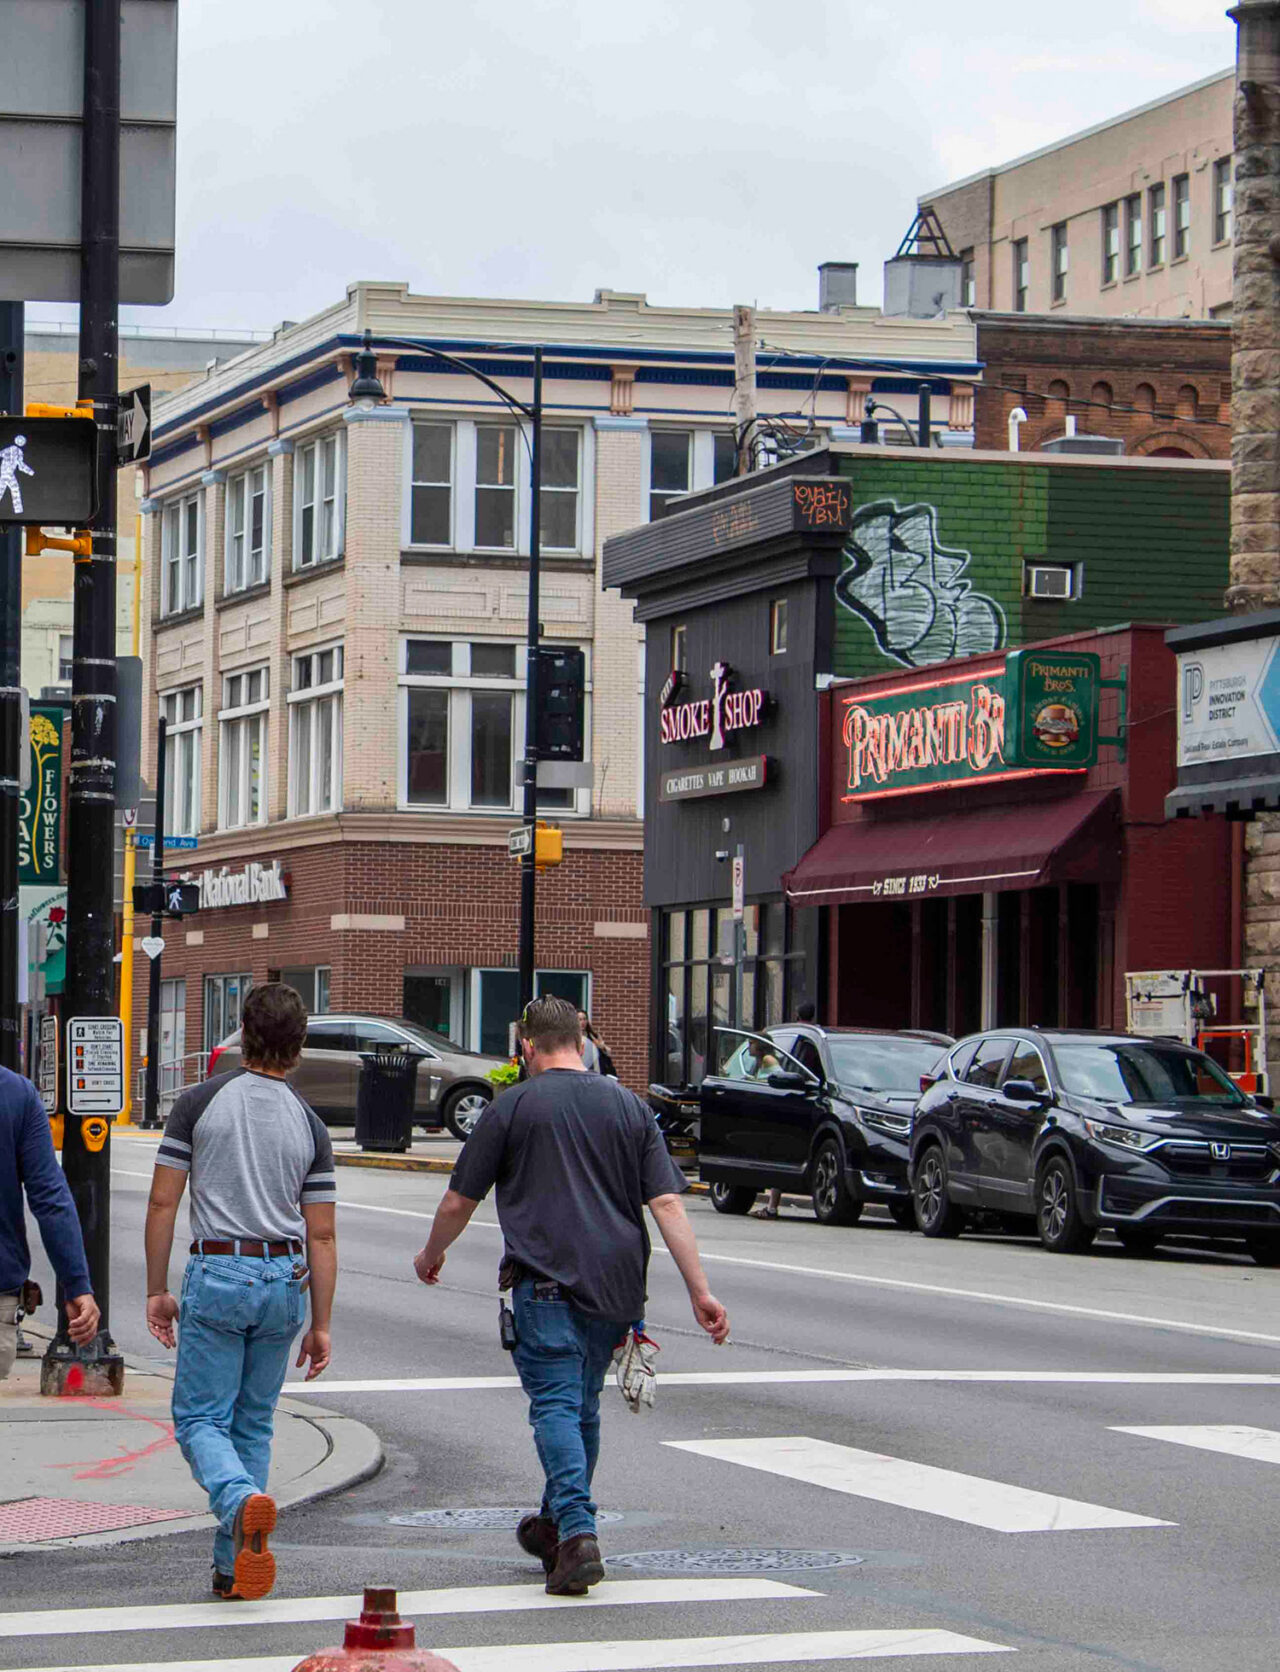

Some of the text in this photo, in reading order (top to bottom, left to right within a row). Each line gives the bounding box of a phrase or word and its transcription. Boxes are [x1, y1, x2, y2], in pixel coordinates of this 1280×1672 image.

[1031, 661, 1090, 680] PRIMANTI
[1209, 675, 1247, 691] PITTSBURGH
[1209, 689, 1246, 706] INNOVATION
[660, 699, 710, 744] SMOKE
[724, 688, 762, 731] SHOP
[1209, 706, 1236, 720] DISTRICT
[842, 700, 968, 788] PRIMANTI
[666, 765, 757, 794] CIGARETTES VAPE HOOKAH
[43, 769, 58, 869] FLOWERS
[180, 839, 194, 848] Ave
[204, 864, 249, 908] National
[250, 860, 287, 902] Bank
[883, 876, 907, 895] SINCE
